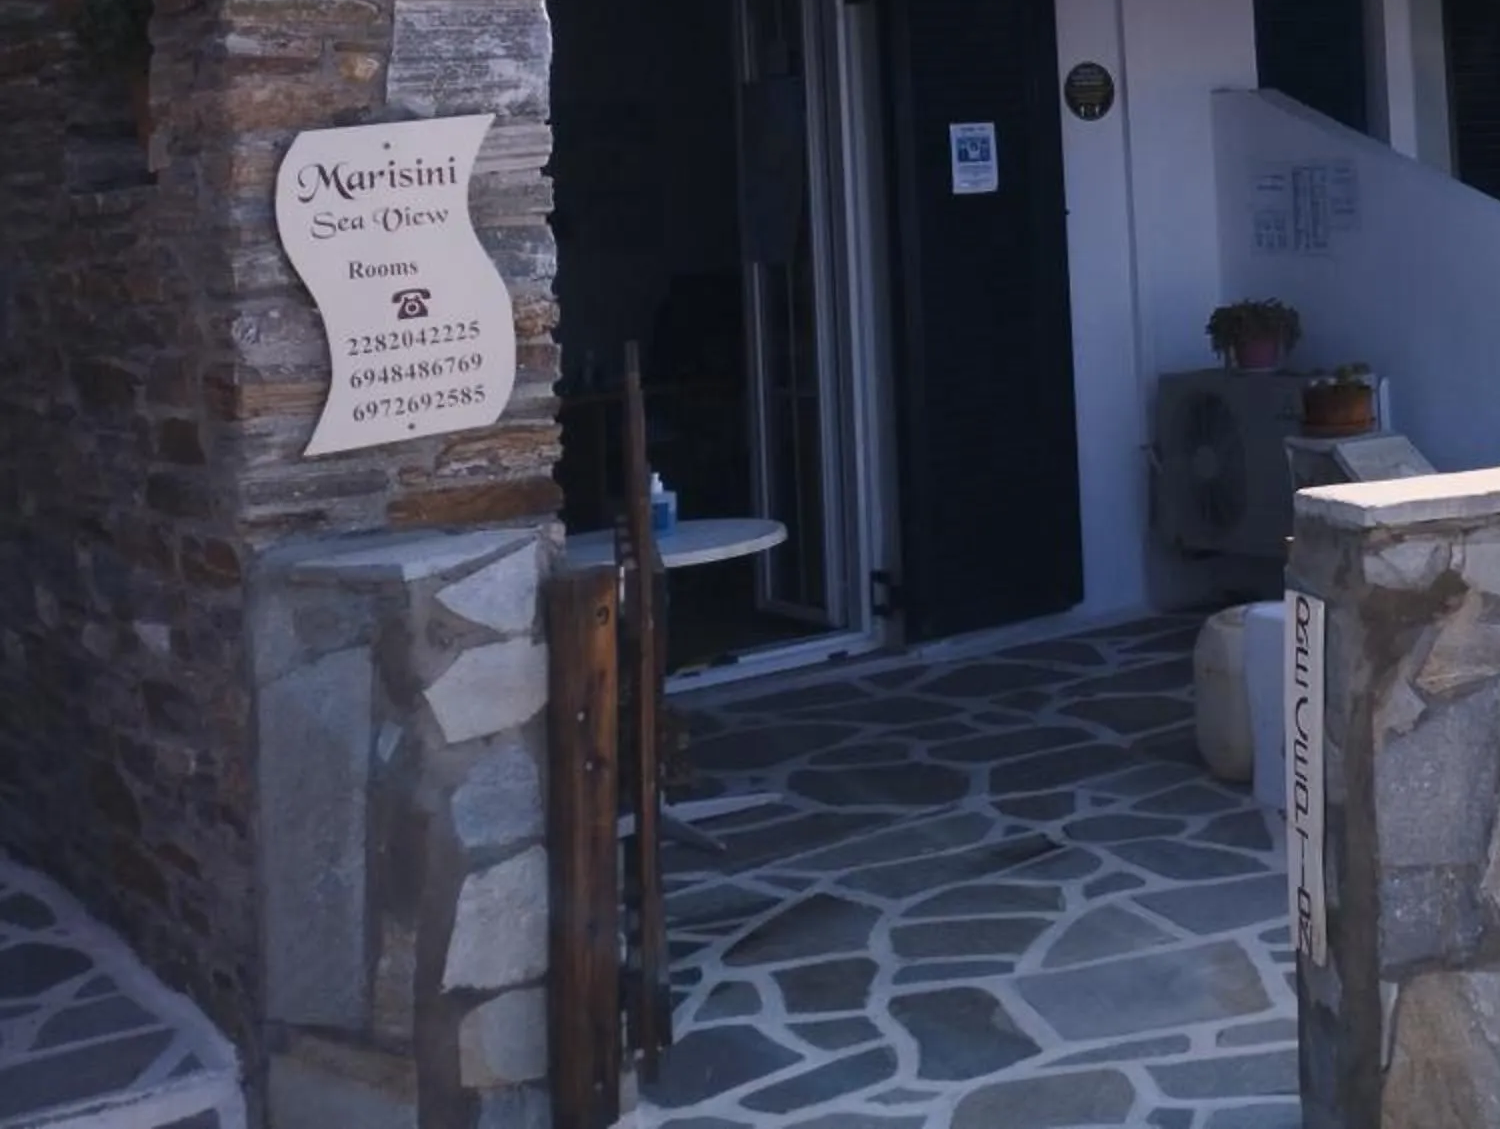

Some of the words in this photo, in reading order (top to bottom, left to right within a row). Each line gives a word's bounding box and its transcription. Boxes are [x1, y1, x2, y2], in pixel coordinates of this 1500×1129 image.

[297, 156, 457, 203] Marisini
[310, 211, 365, 239] Sea
[373, 206, 449, 234] View
[348, 261, 419, 280] Rooms
[346, 320, 481, 357] 2282042225
[350, 353, 482, 389] 6948486769
[352, 384, 486, 422] 6972692585
